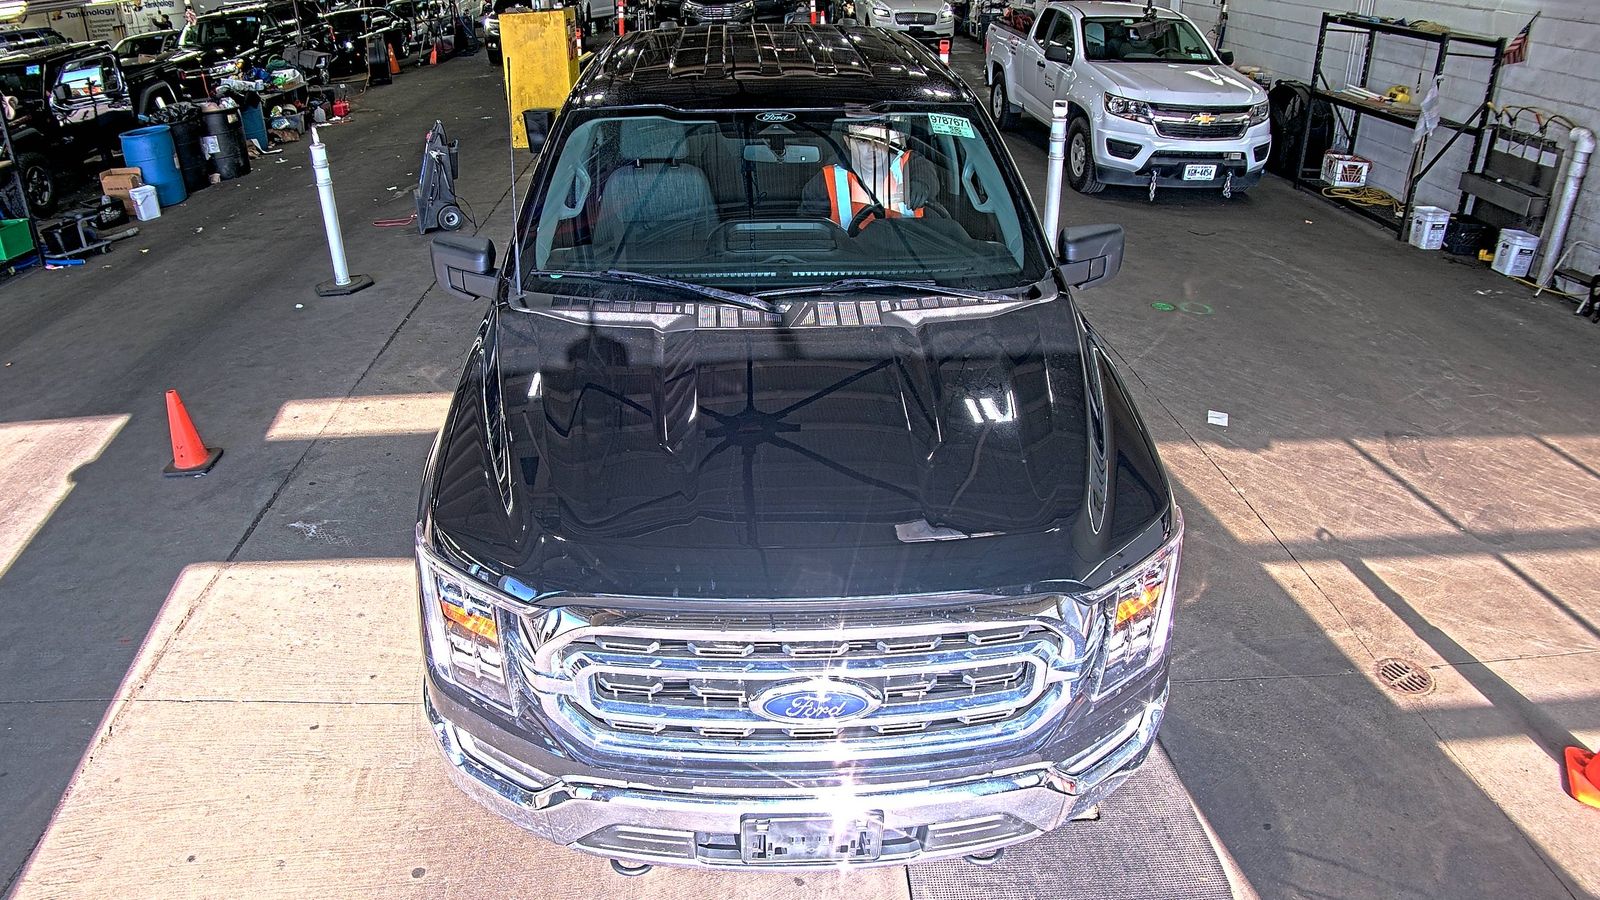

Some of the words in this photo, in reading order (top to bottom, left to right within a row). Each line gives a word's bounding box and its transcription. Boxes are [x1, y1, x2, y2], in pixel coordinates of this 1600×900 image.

[66, 8, 115, 19] Tanknology
[762, 112, 789, 121] Ford
[930, 115, 970, 128] 9787671
[785, 695, 846, 719] Ford
